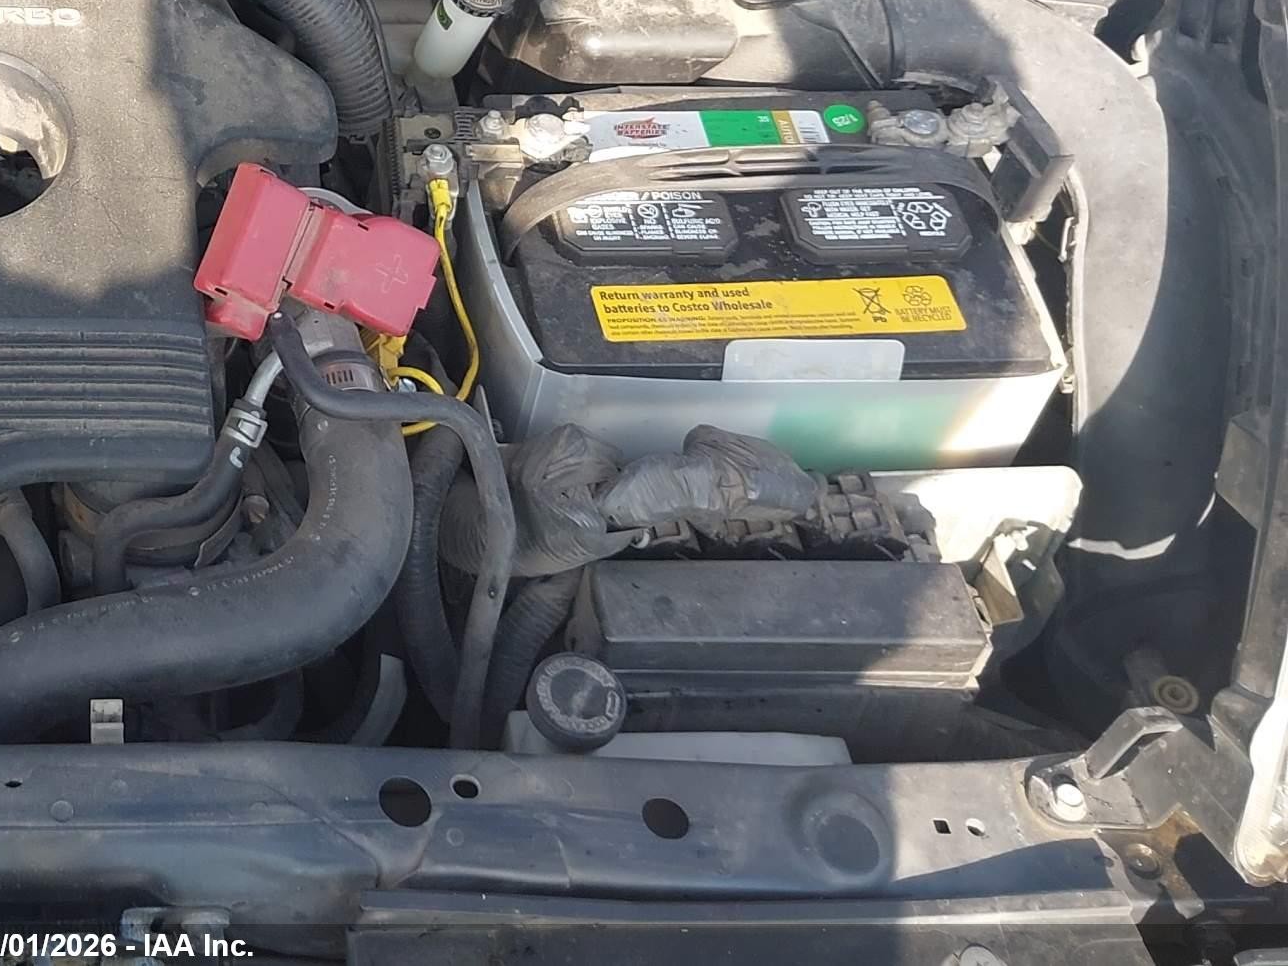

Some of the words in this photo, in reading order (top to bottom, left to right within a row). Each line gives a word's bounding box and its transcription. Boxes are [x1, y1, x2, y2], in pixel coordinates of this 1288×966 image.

[651, 192, 702, 200] POISON
[599, 291, 640, 301] Return
[641, 290, 695, 301] warranty
[697, 288, 718, 298] and
[722, 287, 750, 297] used
[603, 303, 656, 314] batteries
[659, 303, 670, 313] to
[673, 302, 710, 312] Costco
[712, 299, 773, 311] Wholesale
[895, 308, 928, 316] BATTERY
[912, 314, 952, 322] RECYCLED
